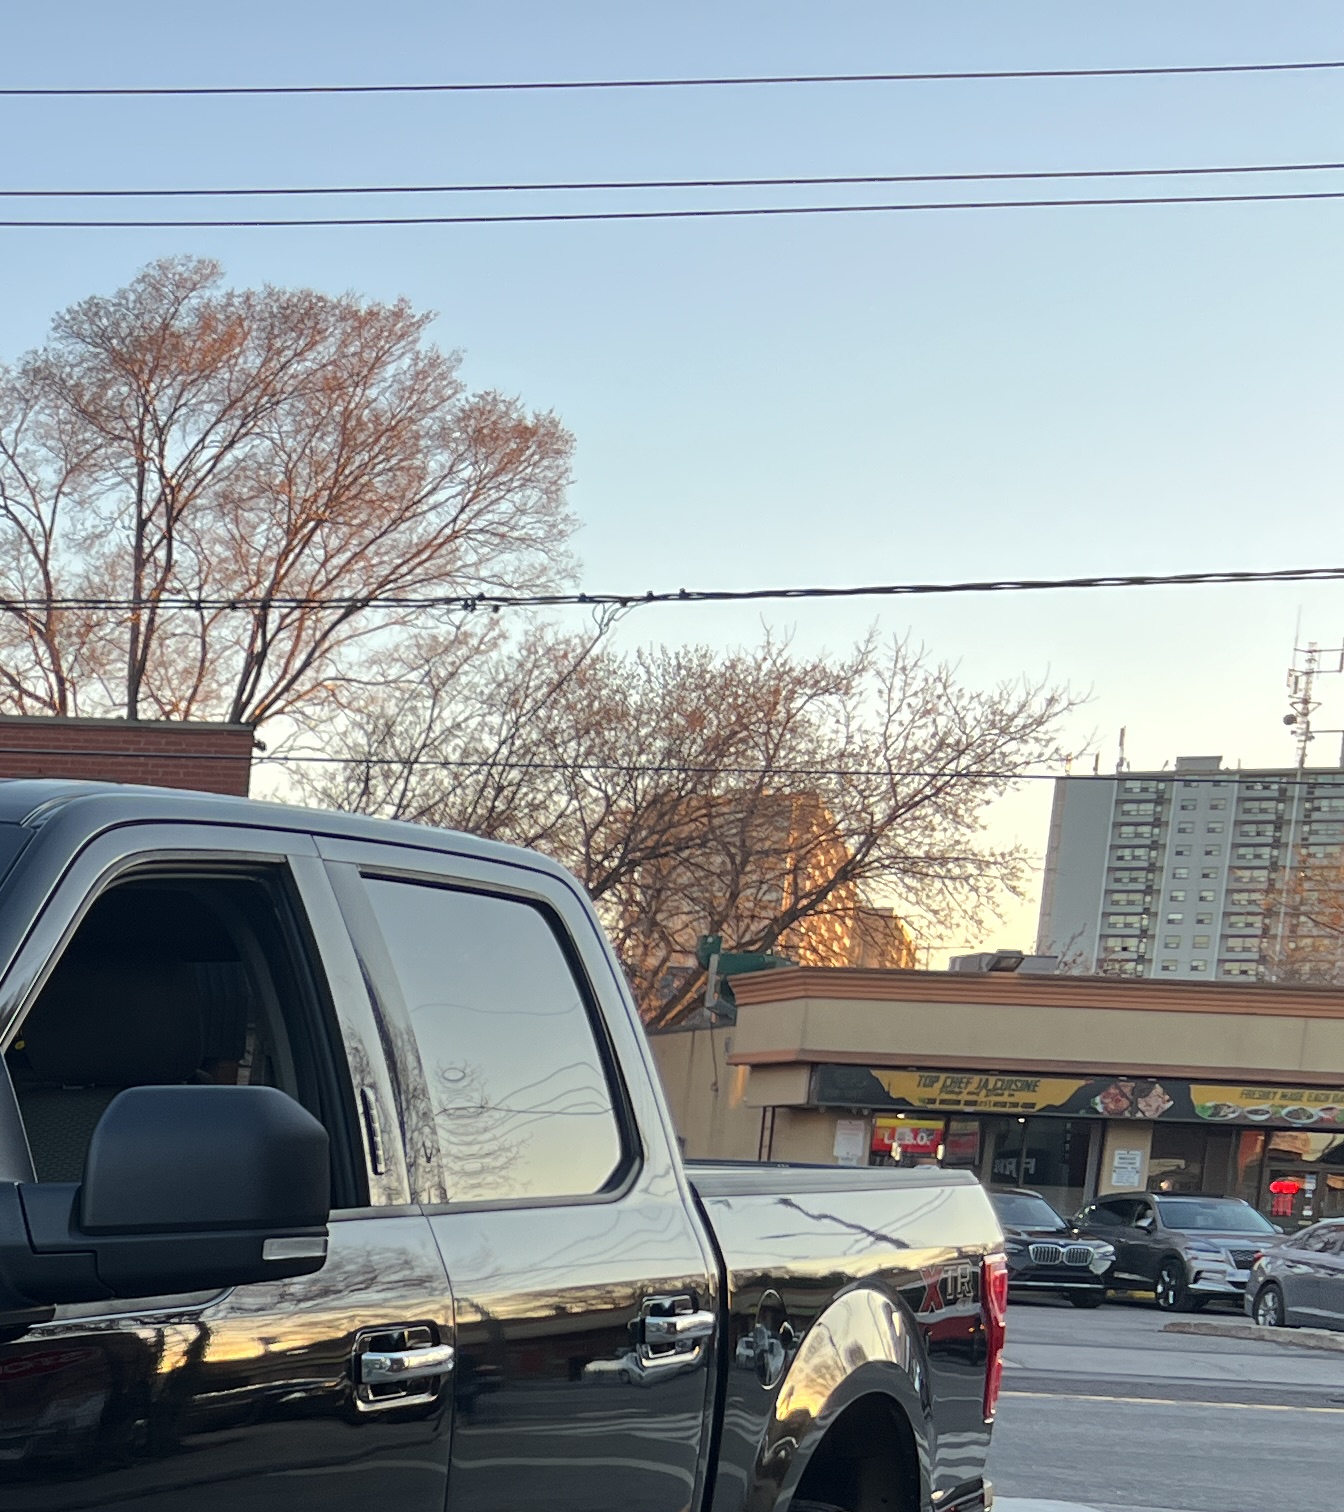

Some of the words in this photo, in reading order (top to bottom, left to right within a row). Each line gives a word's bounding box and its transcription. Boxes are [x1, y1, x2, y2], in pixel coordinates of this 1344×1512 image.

[917, 1074, 941, 1088] TOP
[941, 1075, 973, 1091] CHEF
[918, 1263, 974, 1315] XTR
